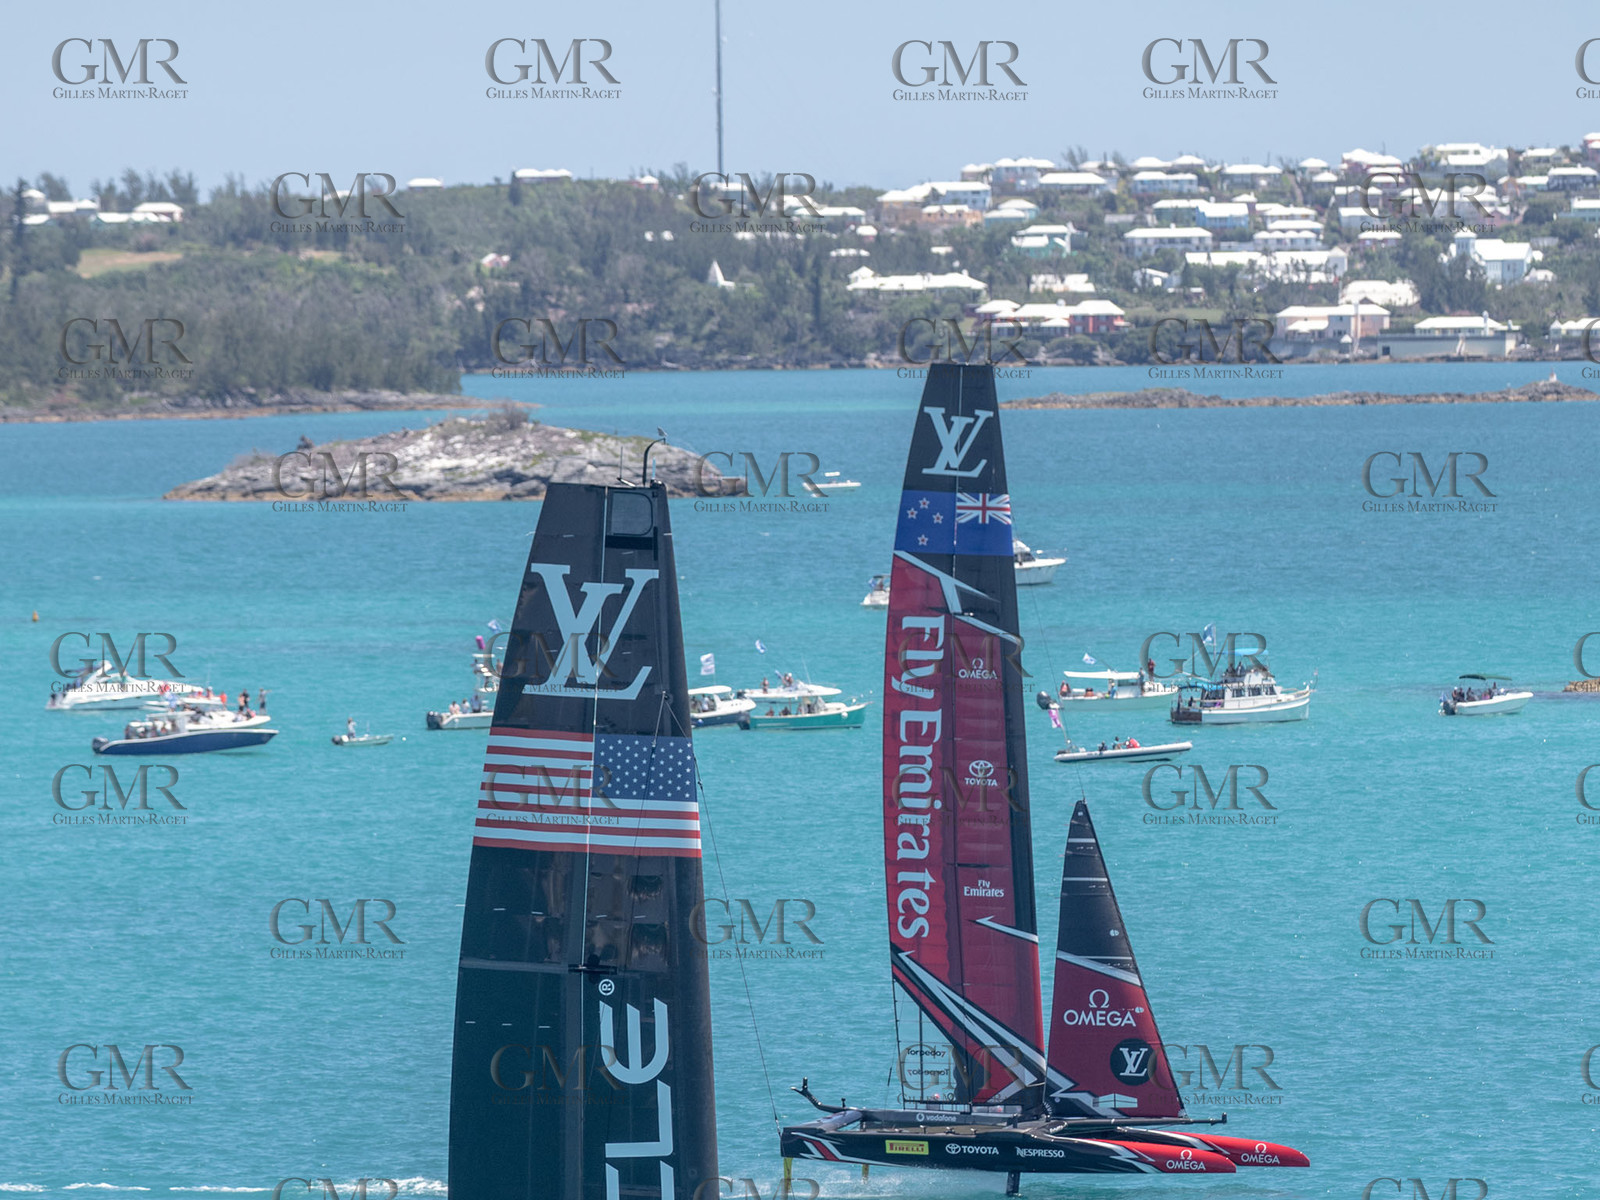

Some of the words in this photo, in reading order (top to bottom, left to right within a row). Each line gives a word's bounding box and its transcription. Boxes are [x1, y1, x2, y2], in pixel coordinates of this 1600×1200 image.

[891, 614, 945, 699] Fly
[958, 669, 998, 680] OMEGA
[964, 777, 998, 787] TOYOTA
[896, 708, 943, 939] Emirates
[977, 879, 991, 889] Fly
[963, 886, 1005, 898] Emirates
[1063, 1009, 1137, 1027] OMEGA
[925, 1114, 957, 1122] vodafone
[961, 1144, 999, 1155] TOYOTA
[1016, 1147, 1065, 1158] NESPRESSO
[1240, 1153, 1280, 1165] OMEGA
[1166, 1159, 1206, 1171] OMEGA
